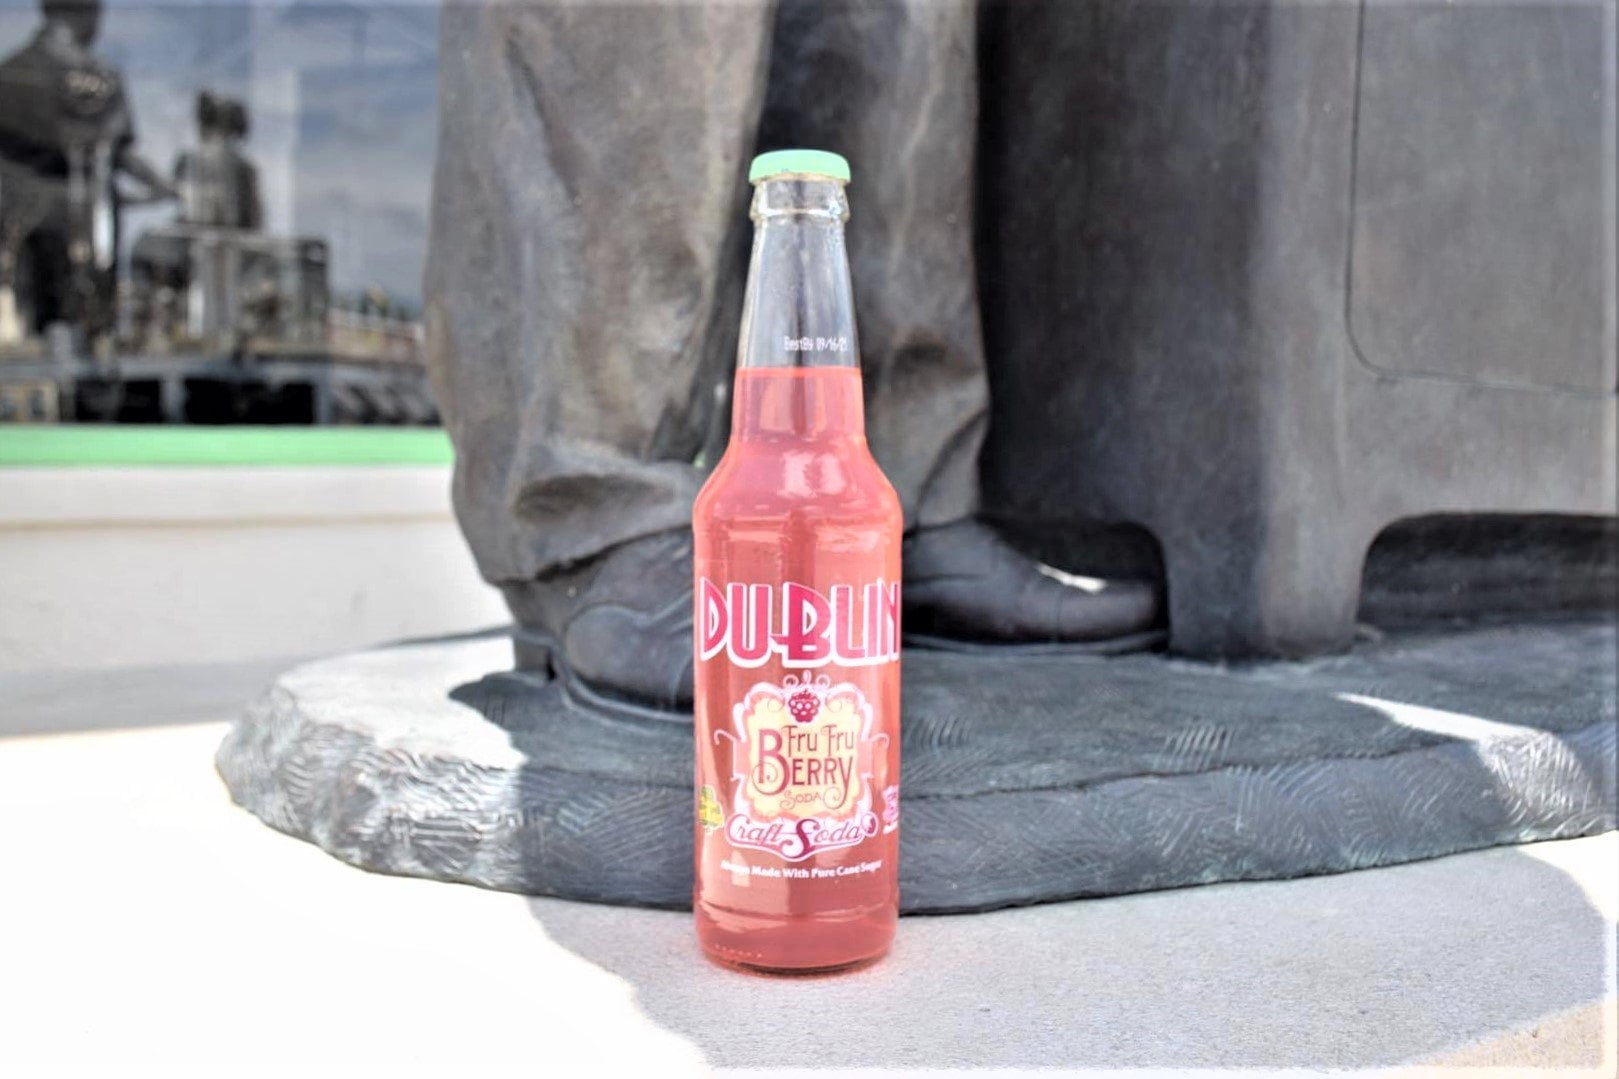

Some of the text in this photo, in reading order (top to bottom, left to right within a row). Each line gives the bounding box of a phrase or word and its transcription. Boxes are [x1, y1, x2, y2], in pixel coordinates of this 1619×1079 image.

[700, 576, 899, 668] DUBLIN
[781, 725, 854, 757] Fru Fru
[727, 813, 861, 859] Craft Soda
[751, 866, 781, 878] Made
[782, 868, 809, 879] With
[811, 868, 836, 879] Pure
[837, 866, 860, 877] Cane
